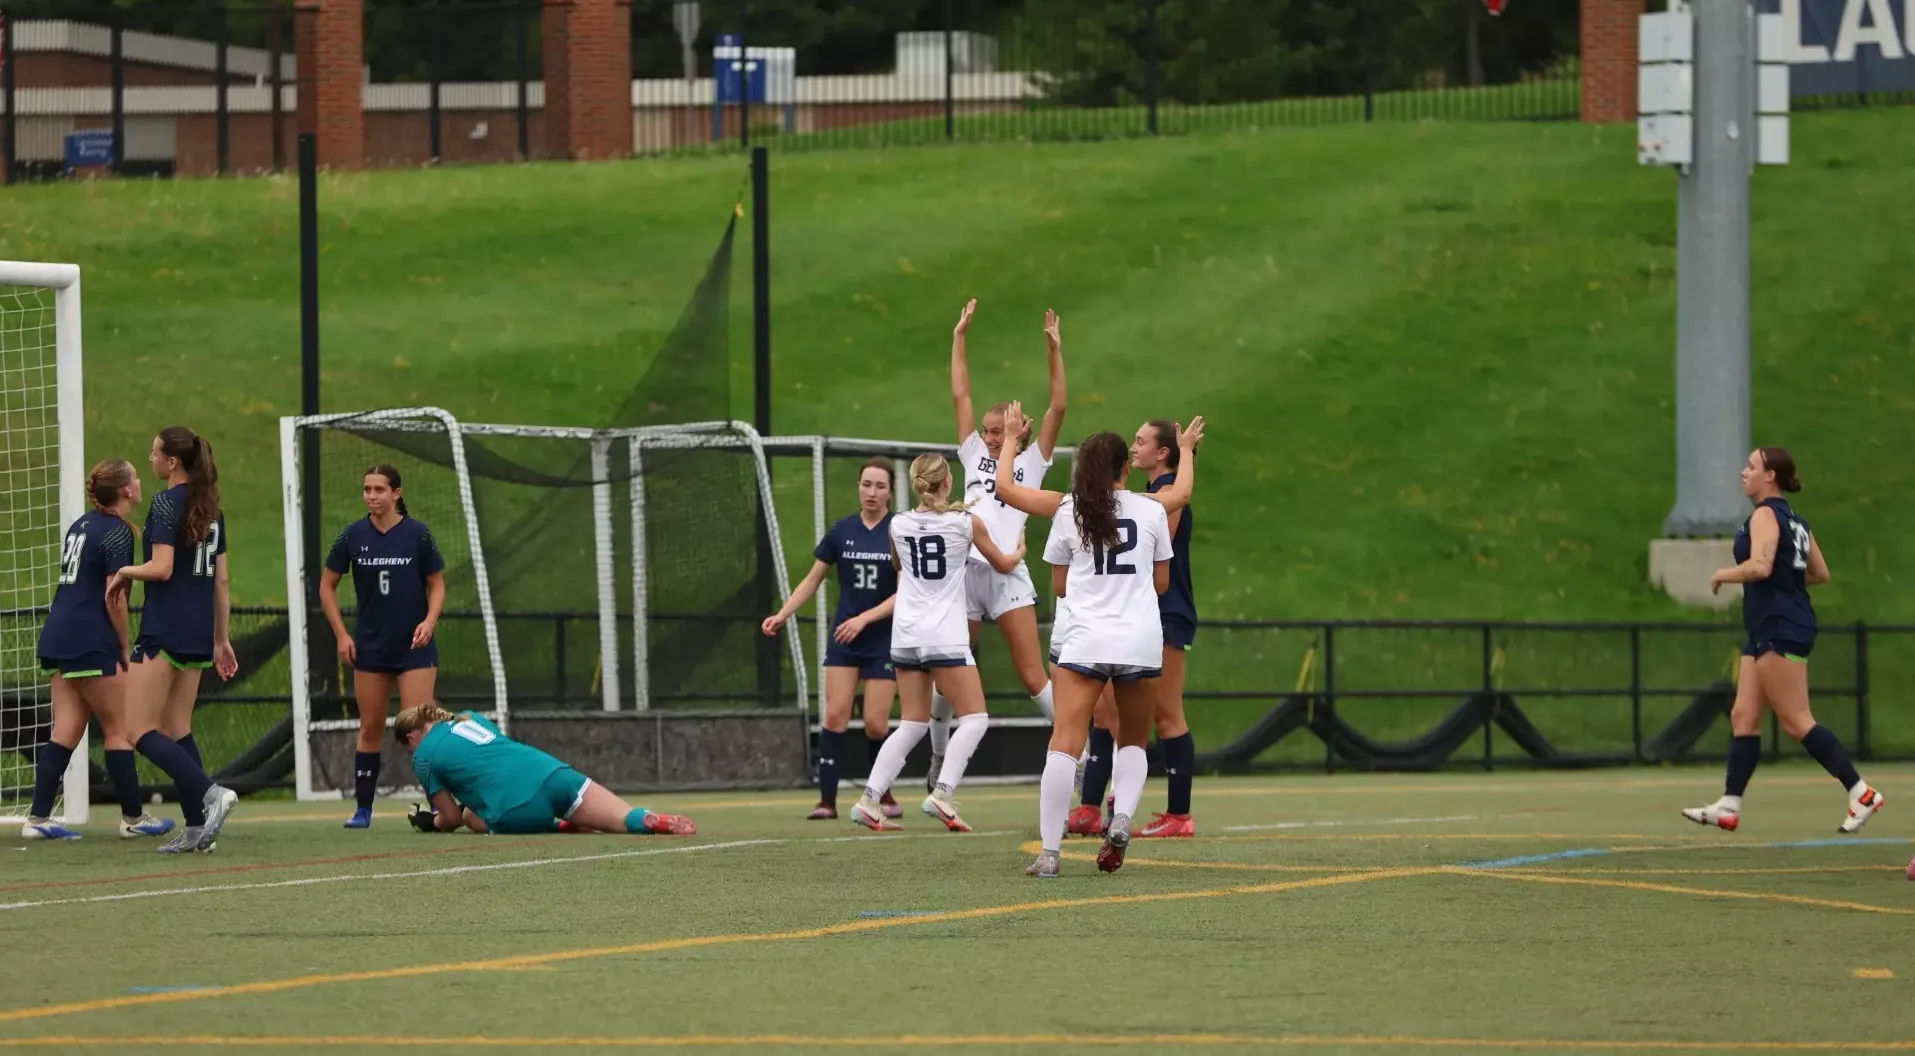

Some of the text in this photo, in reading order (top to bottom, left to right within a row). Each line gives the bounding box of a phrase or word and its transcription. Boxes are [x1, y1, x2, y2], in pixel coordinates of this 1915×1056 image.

[1781, 0, 1915, 62] LA
[59, 533, 87, 585] 28
[193, 520, 219, 577] 12
[358, 557, 412, 566] ALLEGHENY
[842, 551, 892, 561] ALLEGHENY
[904, 534, 947, 580] 18
[1093, 518, 1137, 575] 12
[379, 570, 390, 595] 6
[853, 563, 879, 590] 32
